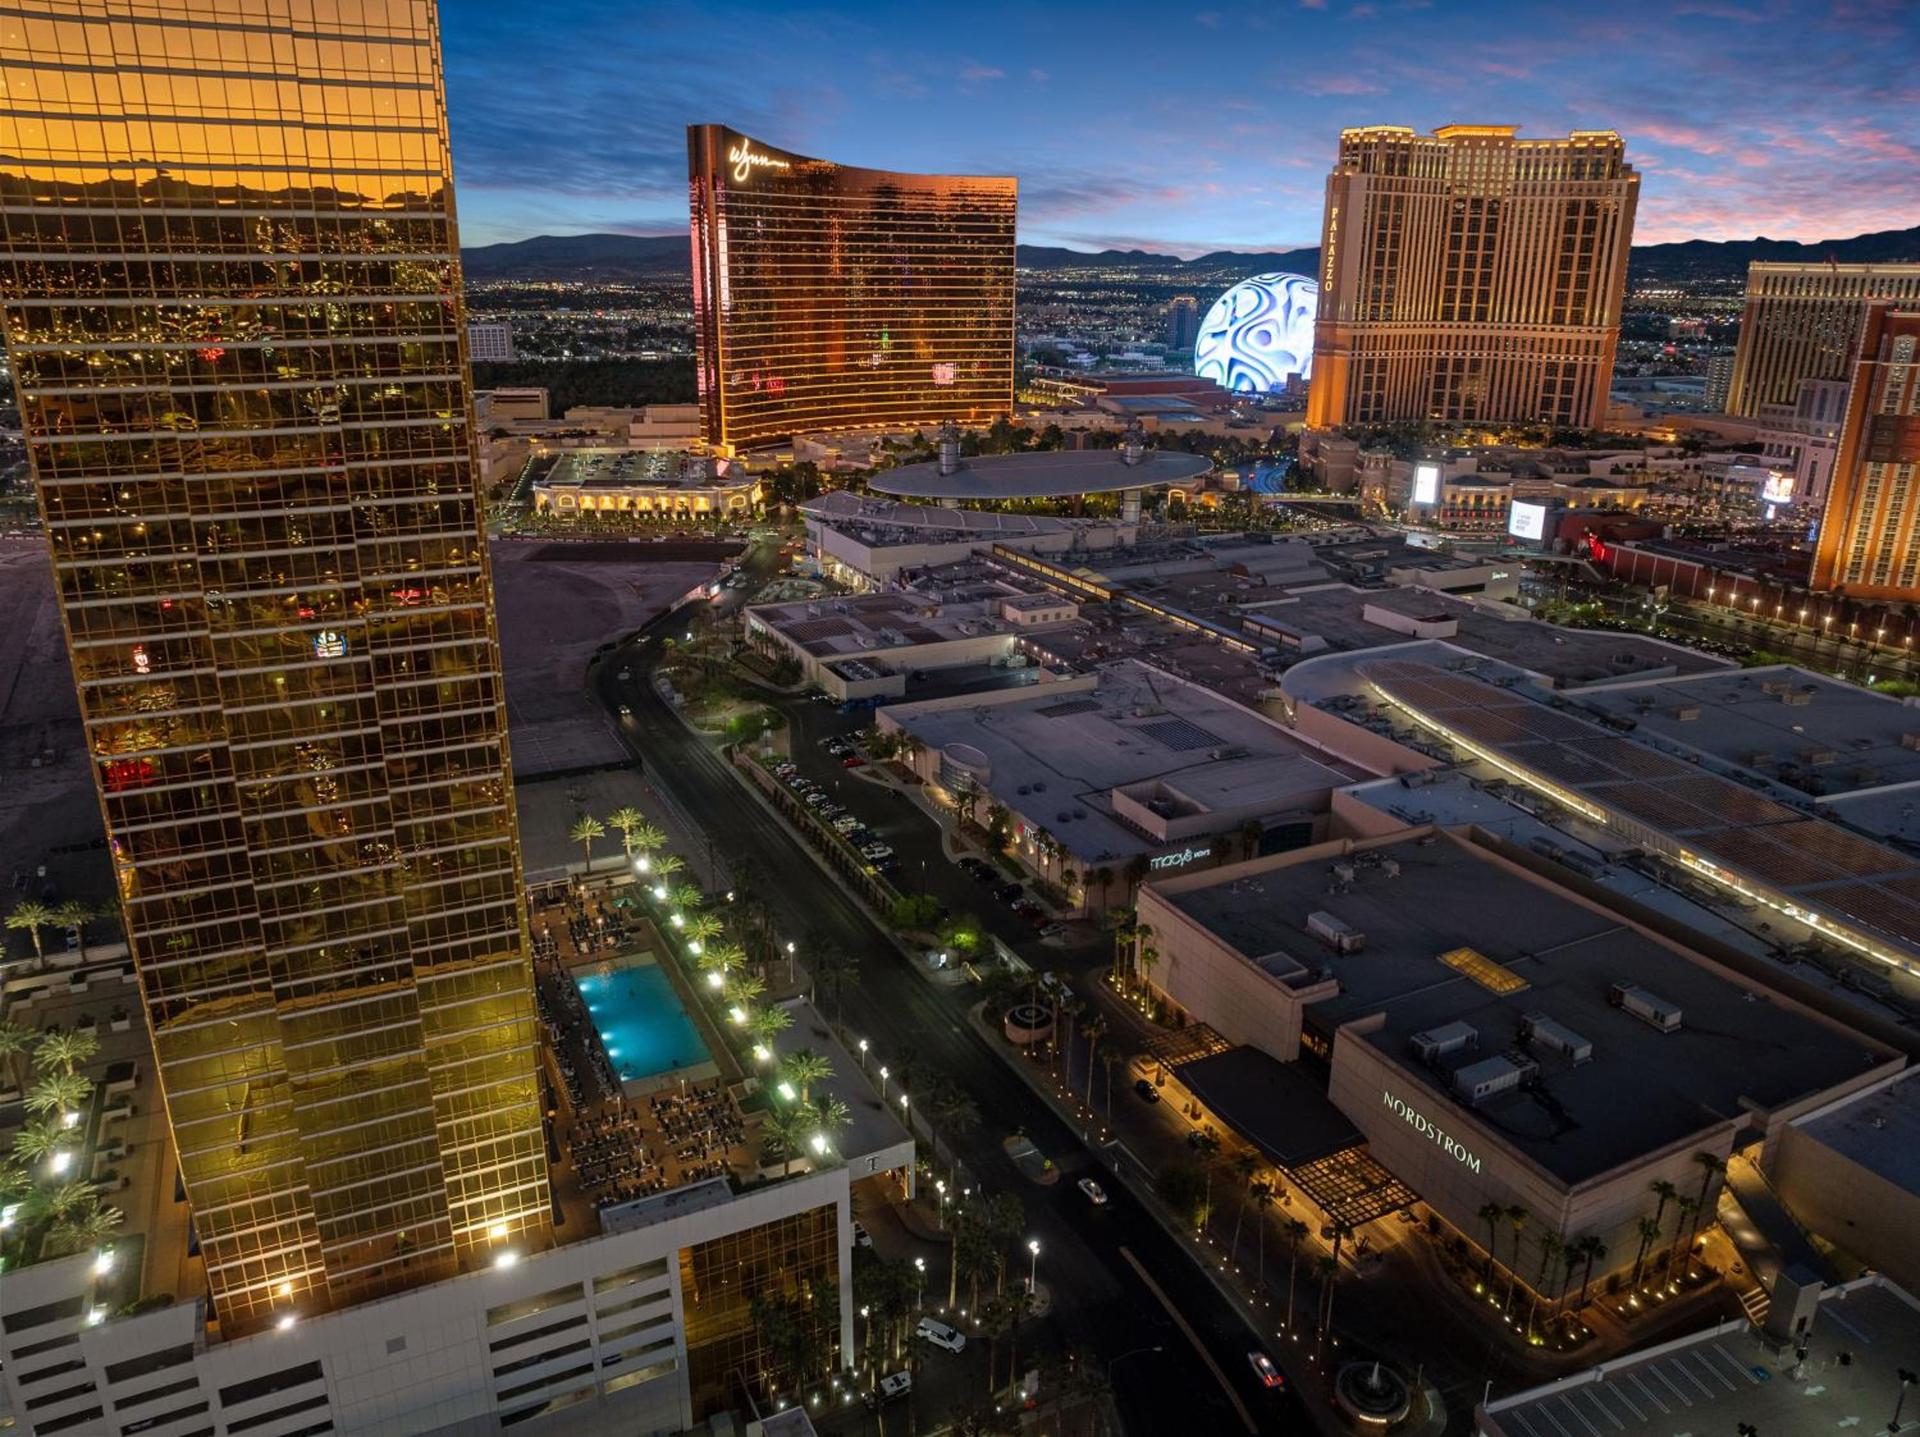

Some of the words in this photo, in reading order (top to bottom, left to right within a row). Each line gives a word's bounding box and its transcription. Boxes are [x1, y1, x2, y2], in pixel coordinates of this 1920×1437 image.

[1325, 207, 1338, 291] PALAZZO
[1150, 848, 1192, 871] macy's
[1383, 1091, 1481, 1175] NORDSTROM
